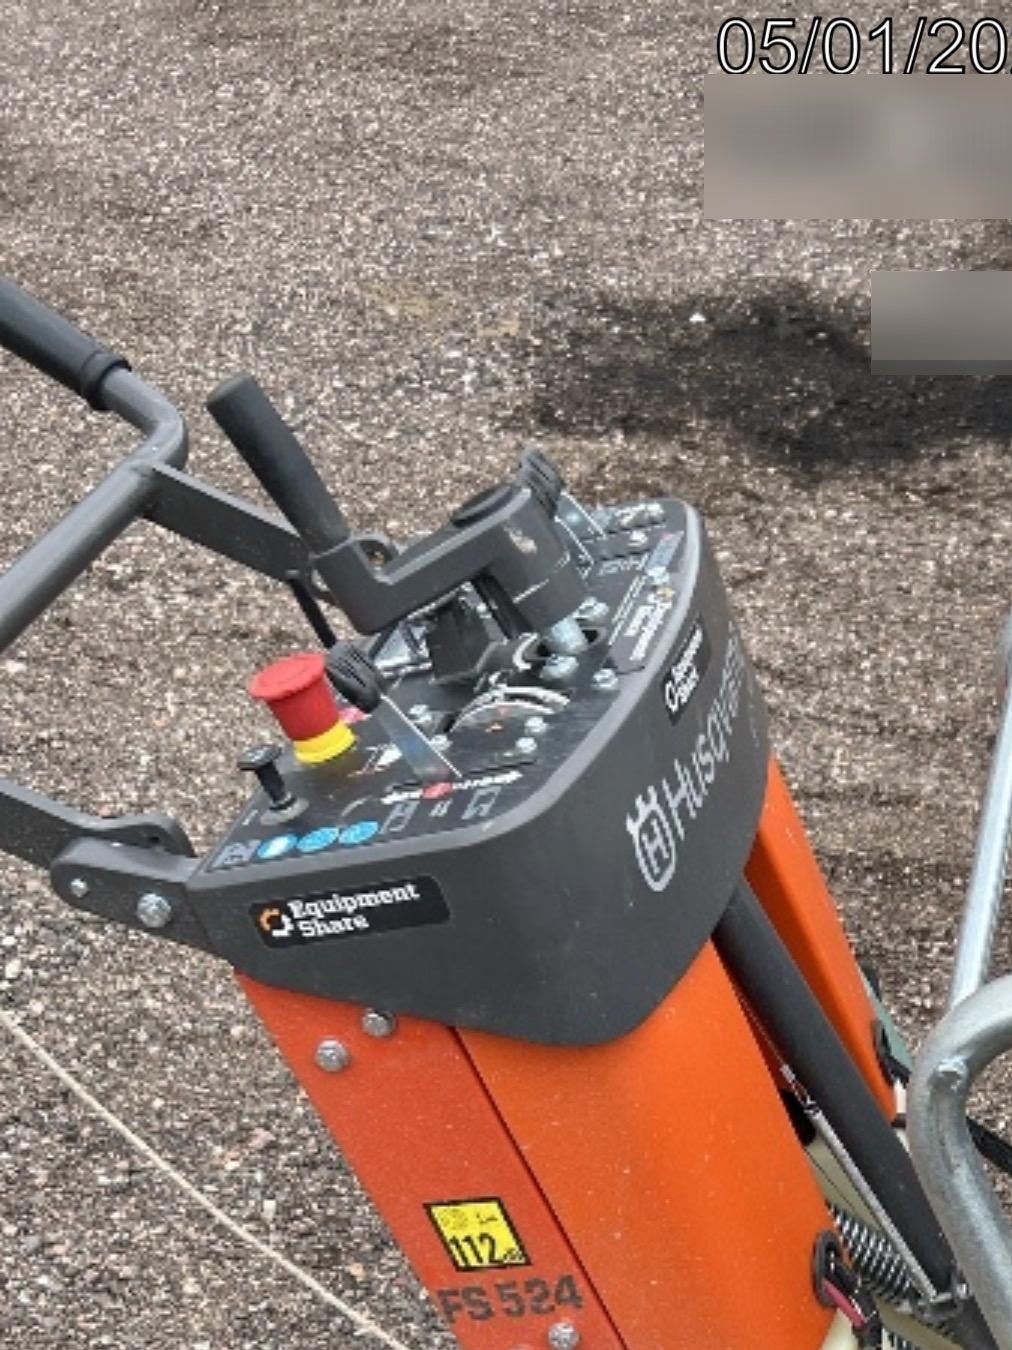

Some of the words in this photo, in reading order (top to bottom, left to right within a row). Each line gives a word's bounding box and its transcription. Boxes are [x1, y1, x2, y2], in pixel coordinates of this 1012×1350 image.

[286, 883, 421, 920] Equipment
[298, 913, 370, 938] Share
[449, 1231, 504, 1268] 112
[437, 1284, 495, 1325] FS
[493, 1273, 584, 1318] 524
